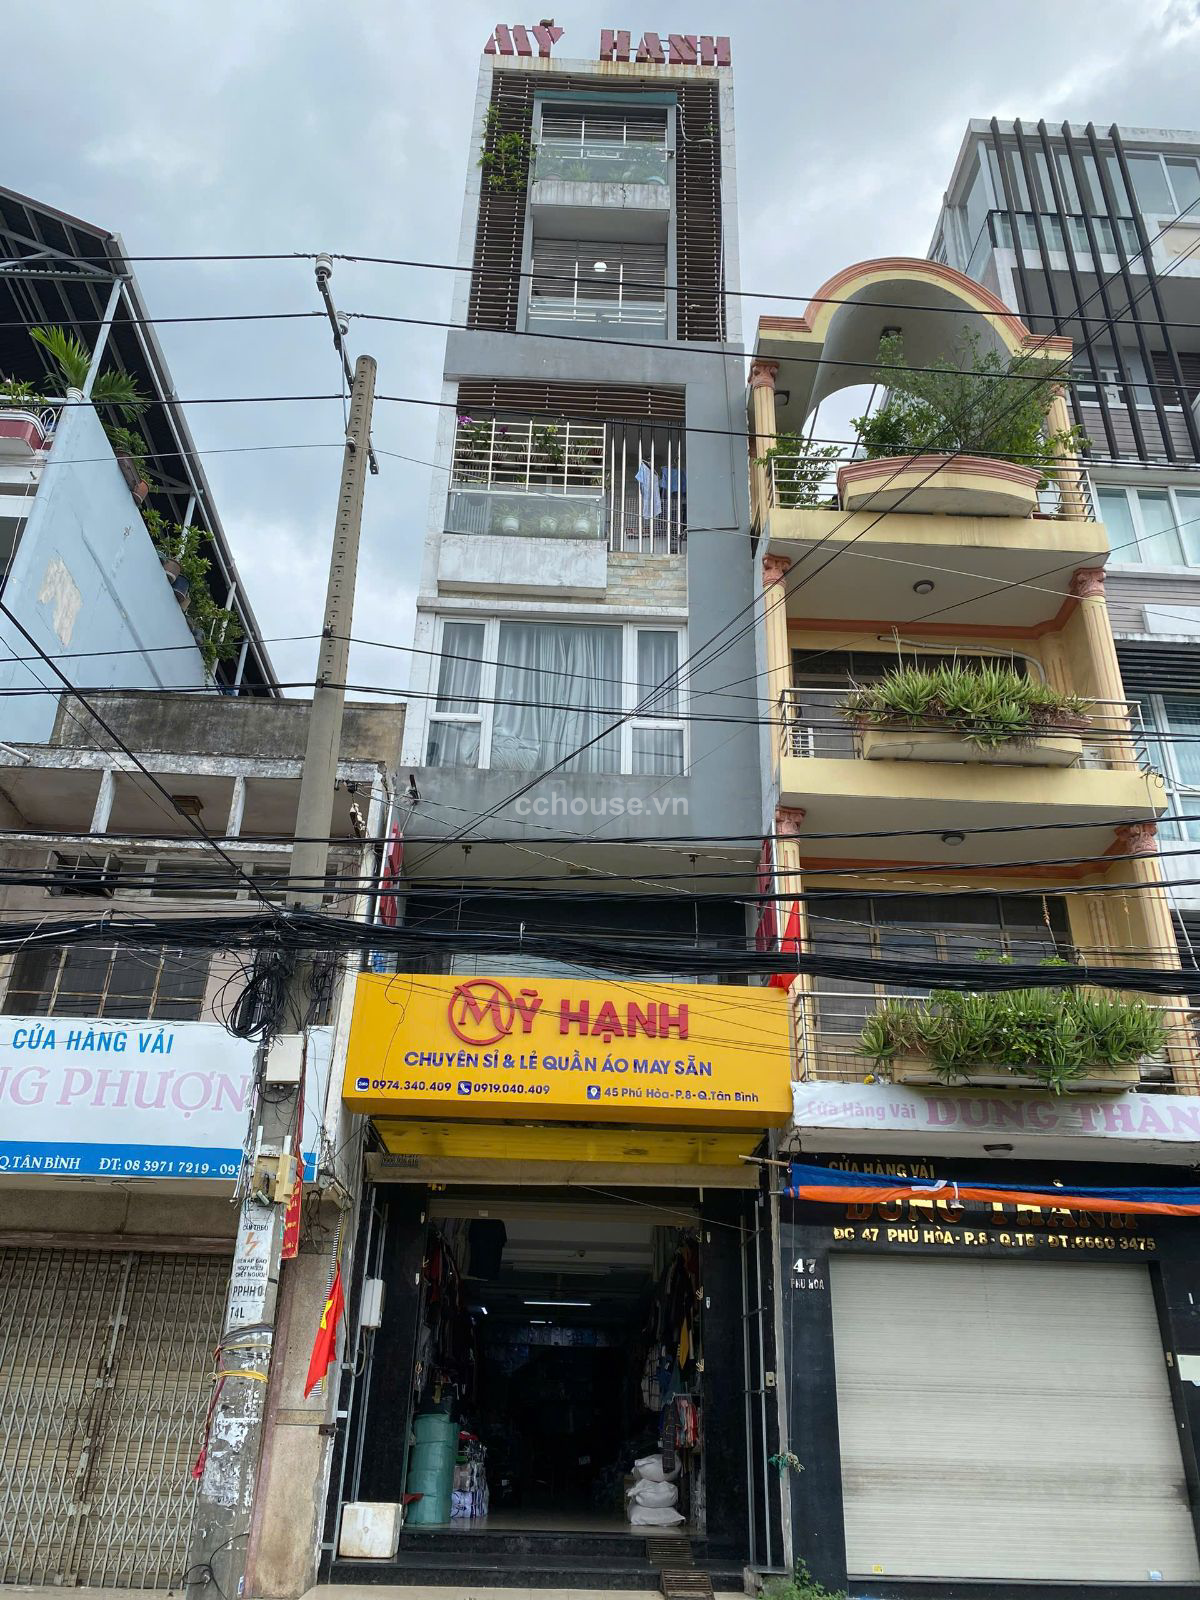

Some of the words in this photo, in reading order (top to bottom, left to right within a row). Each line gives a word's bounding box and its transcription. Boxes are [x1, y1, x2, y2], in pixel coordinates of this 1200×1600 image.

[450, 981, 543, 1042] MỸ
[560, 1000, 688, 1042] HẠNH
[13, 1023, 56, 1050] CỬA
[66, 1028, 127, 1052] HÀNG
[139, 1028, 174, 1054] VẢI
[404, 1050, 478, 1068] CHUYÊN
[503, 1053, 515, 1068] &
[520, 1050, 537, 1069] LẺ
[543, 1050, 597, 1072] QUẦN
[601, 1053, 628, 1073] ÁO
[633, 1059, 671, 1075] MAY
[675, 1055, 712, 1076] SẴN
[56, 1067, 252, 1119] PHƯỢN
[372, 1080, 451, 1091] 0974.340.409
[474, 1083, 550, 1094] 0919.040.409
[604, 1088, 618, 1097] 45
[621, 1088, 642, 1098] Phú
[734, 1091, 759, 1102] Bình
[926, 1096, 1058, 1129] DUNG
[44, 1155, 81, 1170] BÌNH
[125, 1160, 140, 1171] 08
[144, 1160, 173, 1172] 3971
[178, 1162, 209, 1174] 7219
[862, 1228, 879, 1241] 47
[888, 1225, 918, 1243] PHÚ
[1120, 1237, 1156, 1251] 3475
[793, 1258, 816, 1273] 47
